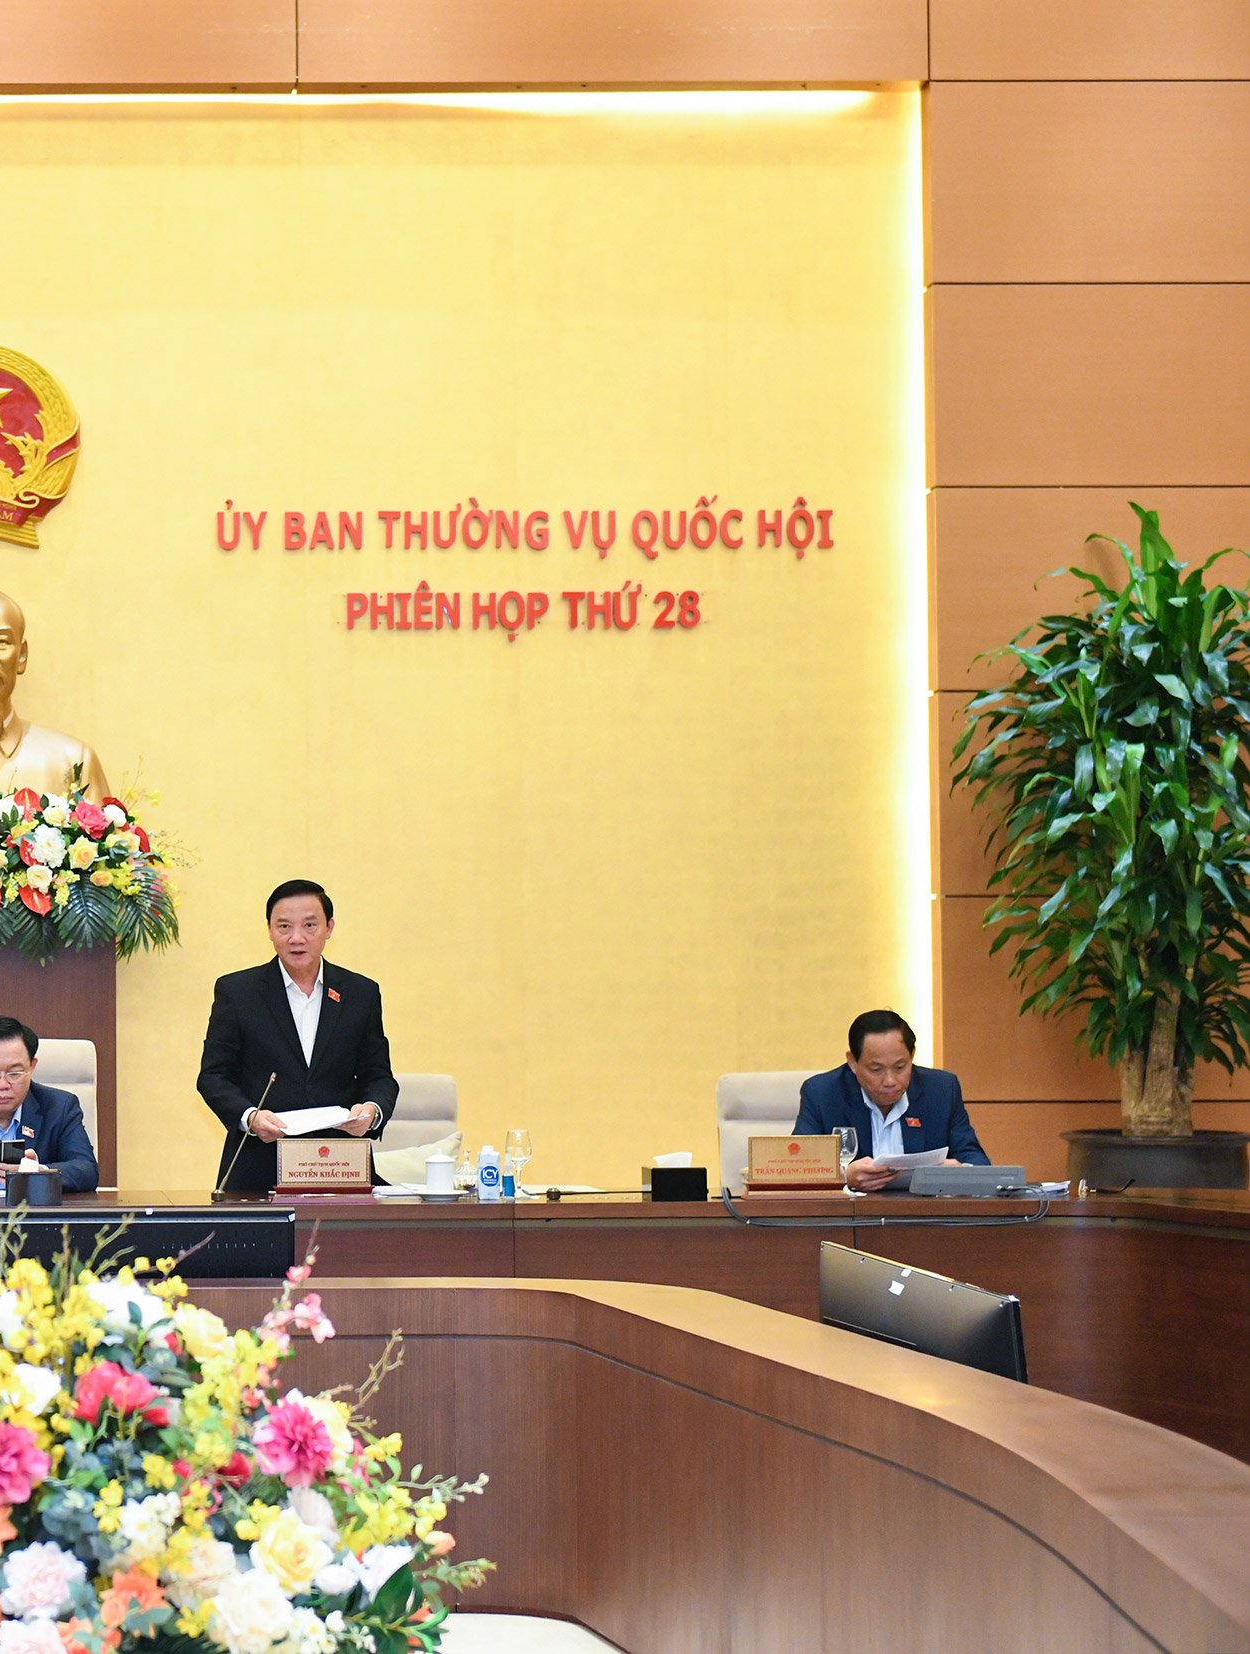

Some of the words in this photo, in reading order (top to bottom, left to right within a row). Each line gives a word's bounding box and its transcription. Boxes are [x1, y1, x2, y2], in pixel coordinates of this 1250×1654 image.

[216, 499, 267, 551] ỦY
[284, 511, 363, 550] BAN
[378, 497, 549, 551] THƯỜNG
[563, 510, 617, 558] VỤ
[631, 496, 743, 559] QUỐC
[757, 496, 834, 559] HỘI
[346, 580, 462, 630] PHIÊN
[472, 590, 549, 641] HỌP
[561, 580, 642, 631] THỨ
[653, 590, 702, 630] 28
[482, 1169, 498, 1178] ICY
